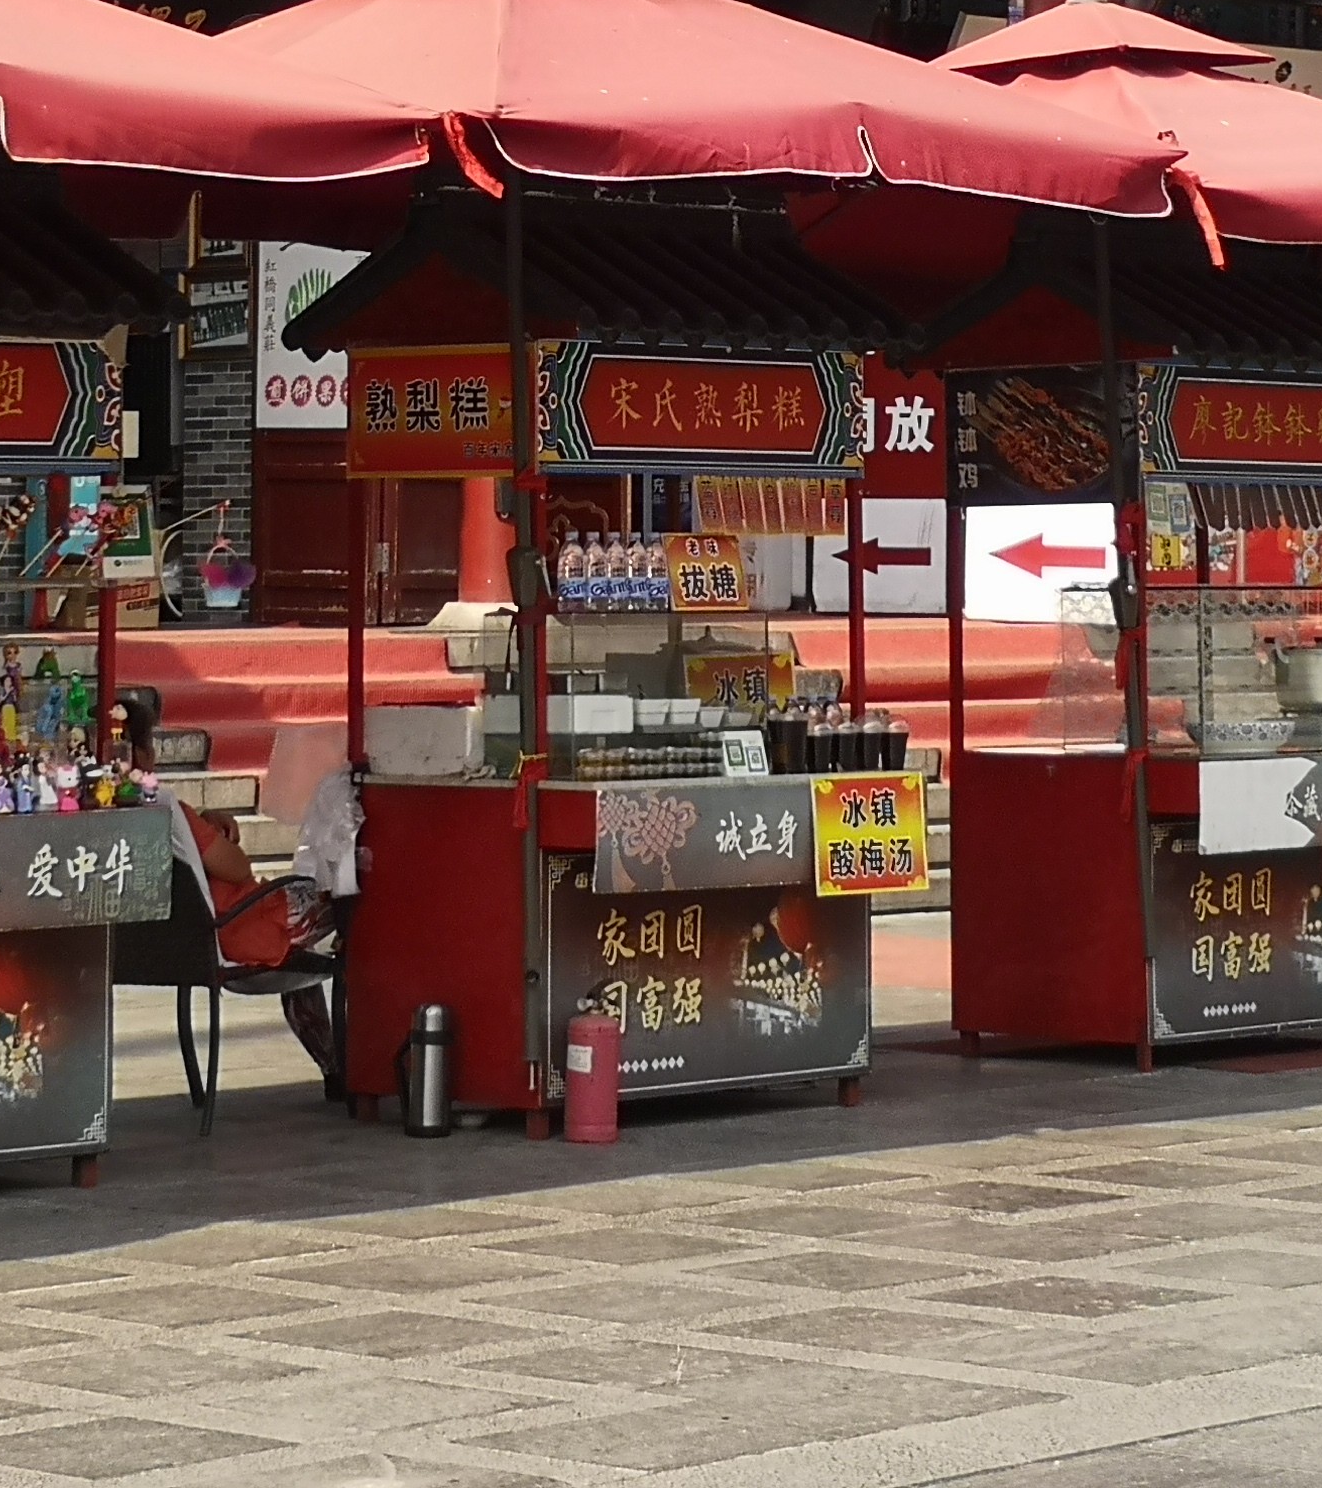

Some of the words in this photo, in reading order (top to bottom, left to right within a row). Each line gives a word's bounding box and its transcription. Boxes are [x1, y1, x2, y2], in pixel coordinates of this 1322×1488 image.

[364, 377, 490, 433] 熟梨糕
[609, 376, 807, 433] 宋氏熟梨糕
[865, 396, 936, 454] 放
[686, 537, 720, 558] 老味
[679, 562, 739, 601] 拔糖
[840, 788, 897, 828] 冰镇
[714, 810, 799, 861] 诚立身
[828, 838, 915, 879] 酸梅汤
[27, 837, 135, 899] 爱中华
[1190, 867, 1274, 923] 家团圆
[596, 904, 703, 967] 家团圆
[1190, 930, 1274, 983] 国富强
